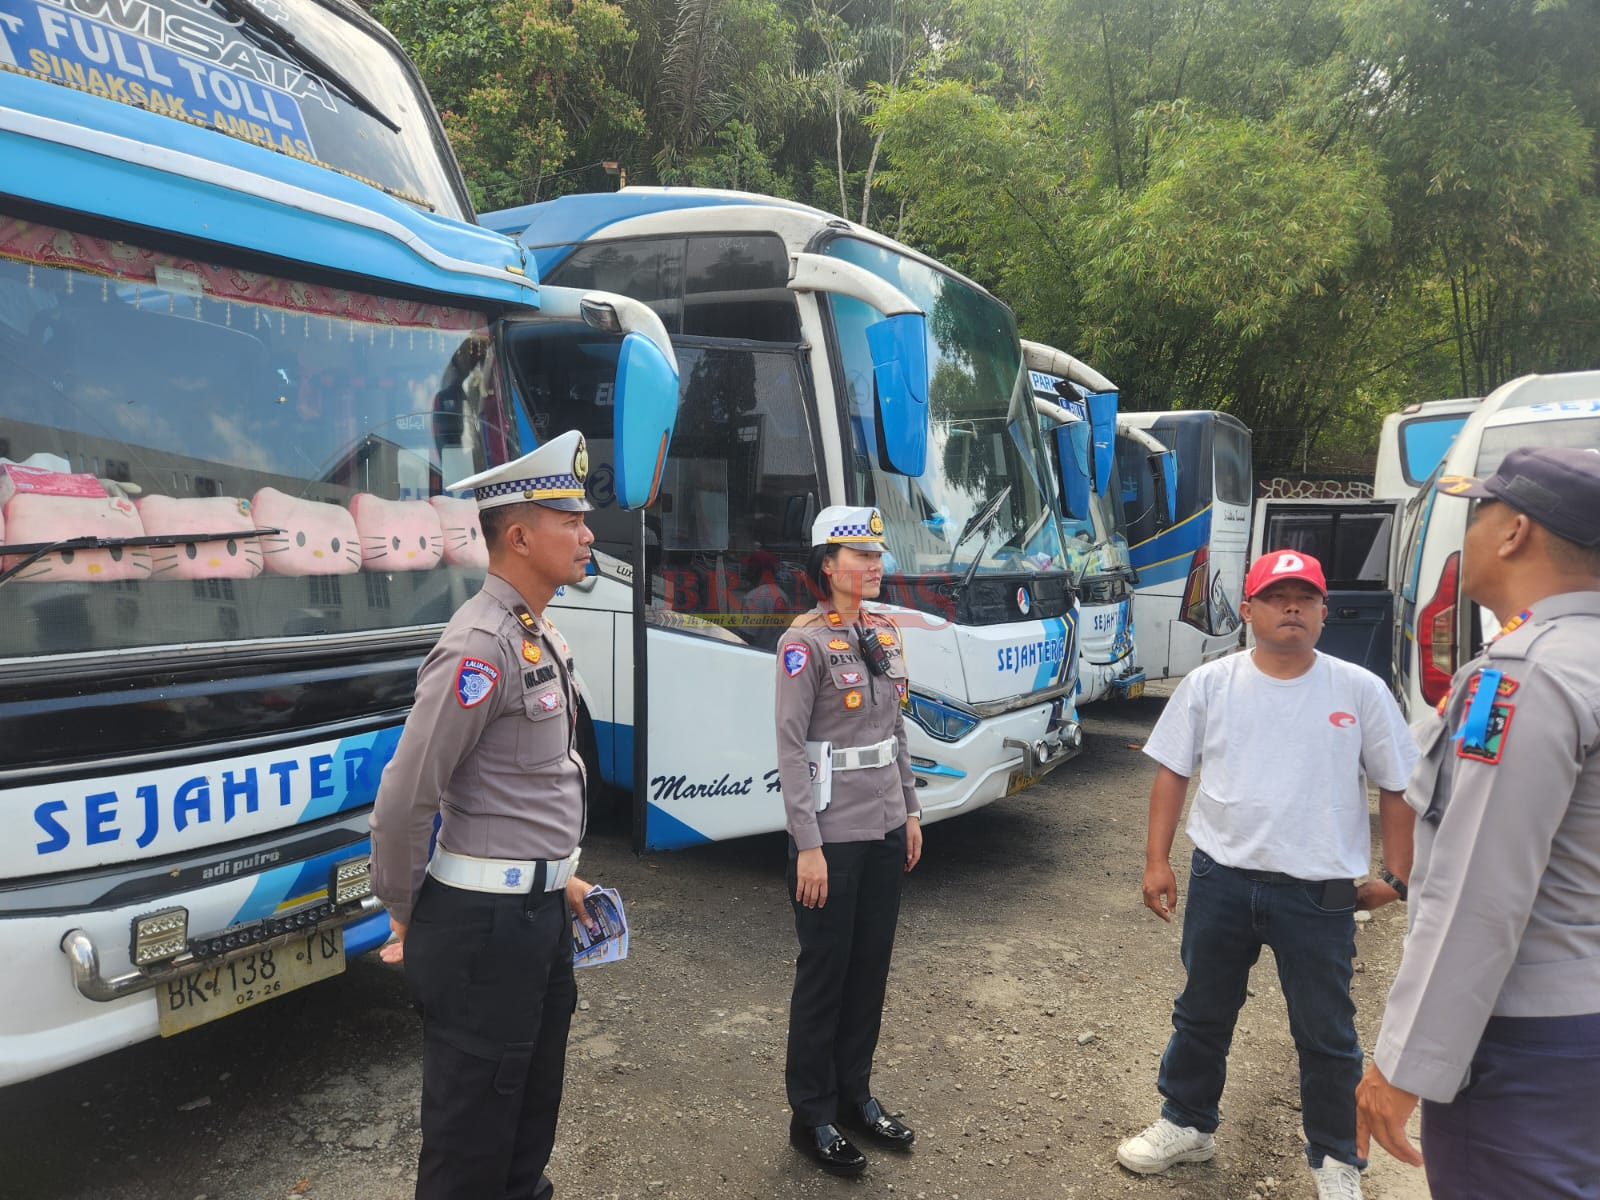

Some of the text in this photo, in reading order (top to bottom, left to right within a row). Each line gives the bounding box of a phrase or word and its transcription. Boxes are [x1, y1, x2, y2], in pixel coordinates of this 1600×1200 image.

[34, 0, 339, 113] WISATA
[37, 5, 173, 88] FULL
[177, 57, 293, 131] TOLL
[29, 48, 186, 114] SINAKSAK
[213, 109, 312, 158] AMPLAS
[616, 565, 633, 577] LUX
[1271, 553, 1304, 575] D
[997, 637, 1065, 675] SEJAHTERA
[34, 742, 398, 855] SEJAHTER
[651, 773, 753, 801] Marihat
[202, 850, 280, 880] adi putro
